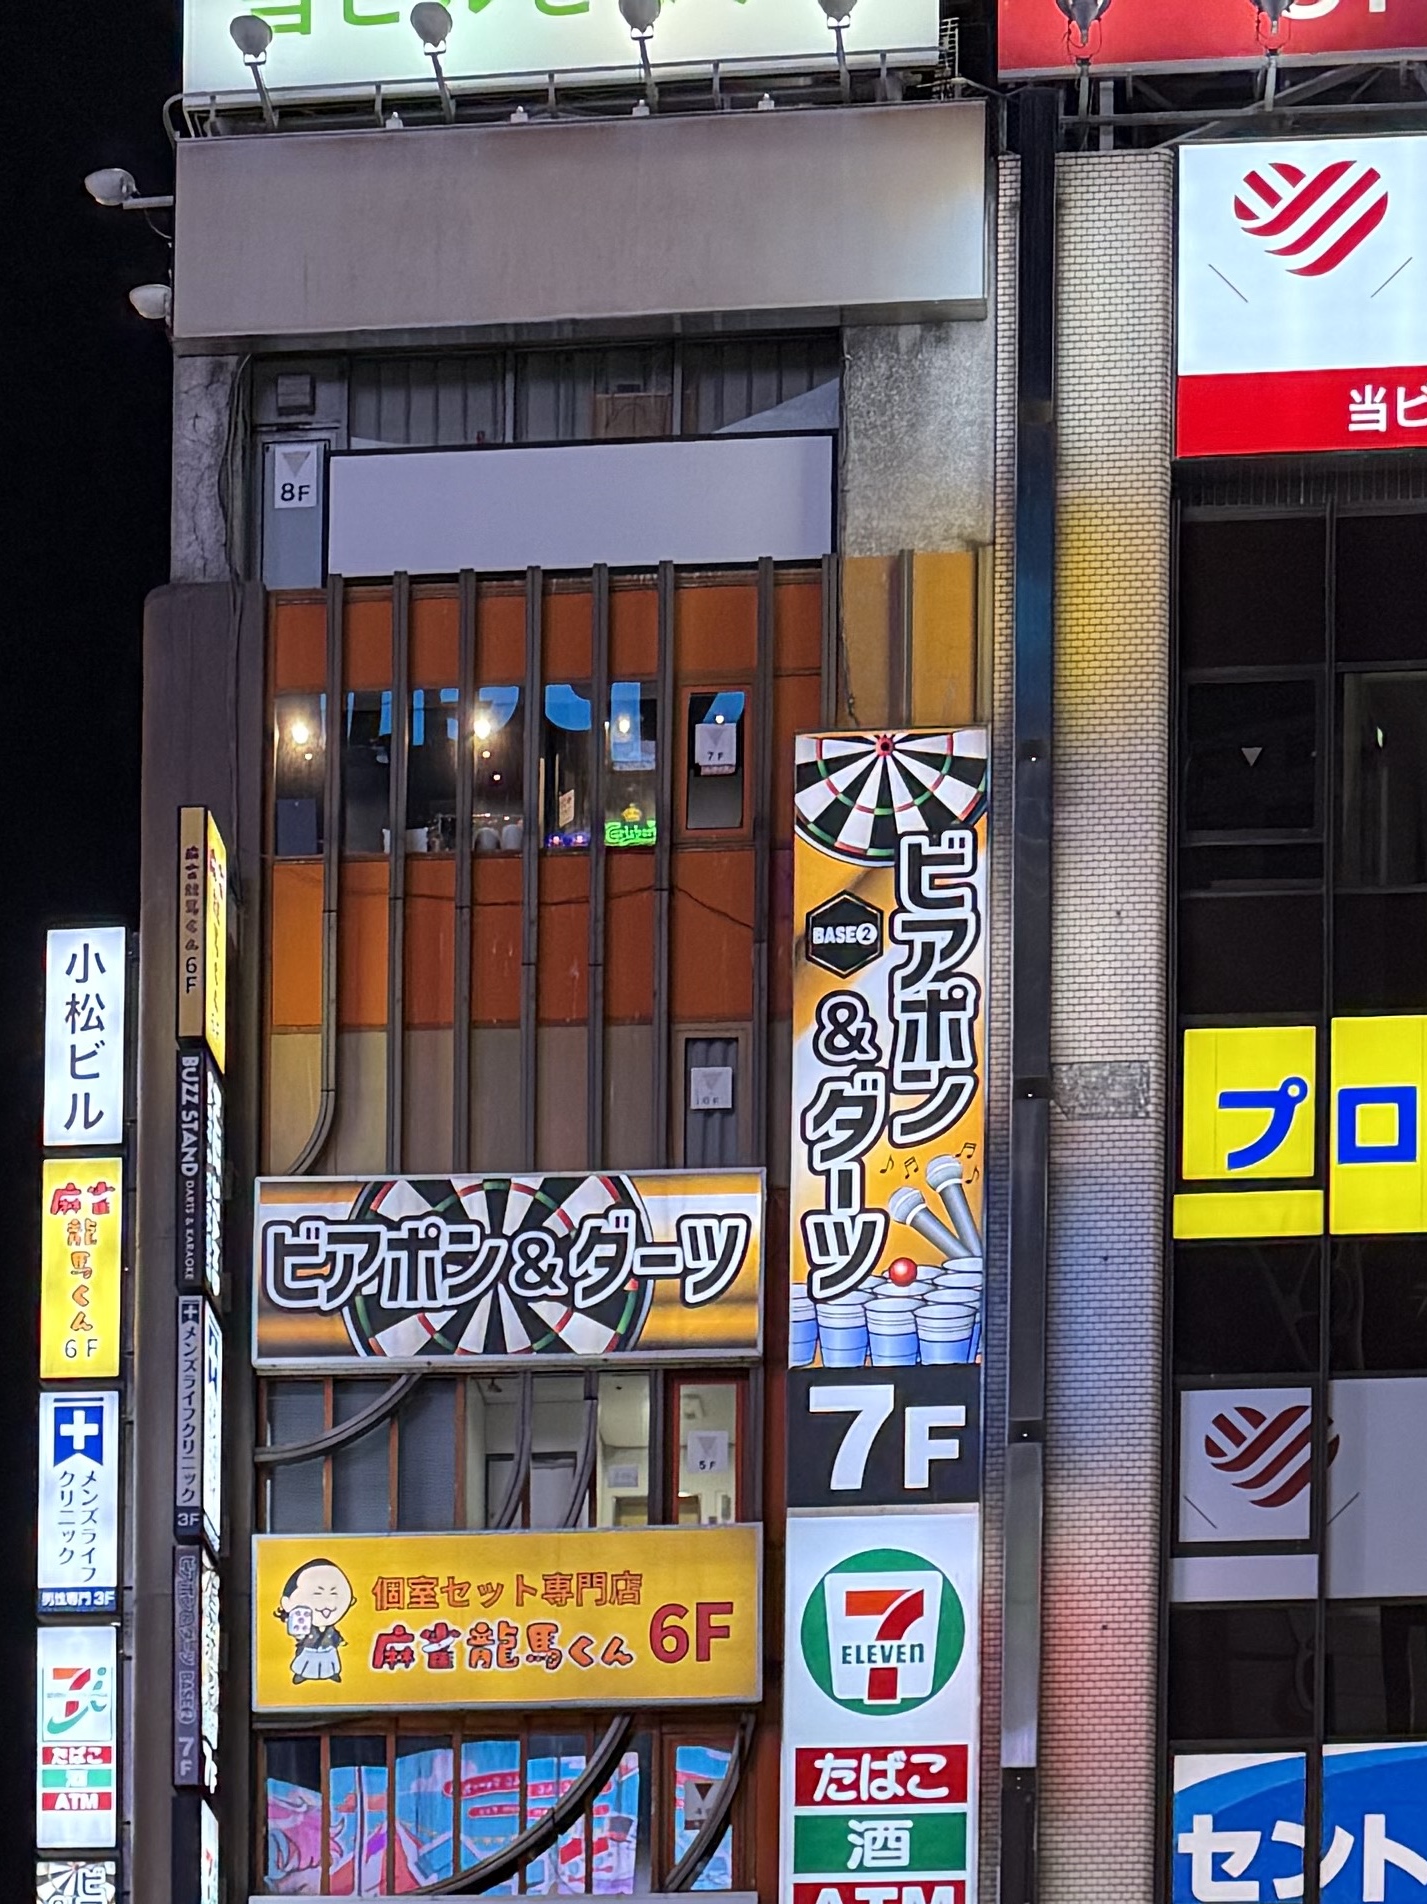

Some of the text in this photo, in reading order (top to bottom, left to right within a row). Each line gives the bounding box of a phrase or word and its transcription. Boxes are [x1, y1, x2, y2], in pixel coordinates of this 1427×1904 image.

[280, 481, 311, 503] 8F
[184, 956, 197, 994] 6F
[890, 828, 980, 1148] ビアポン
[62, 940, 108, 1133] 小松ビル
[180, 1055, 199, 1107] BUZZ
[180, 1110, 199, 1176] STAND
[264, 1208, 753, 1310] ビアポン&ダーツ
[63, 1336, 98, 1360] 6F
[180, 1322, 198, 1505] メンズライフクリニック
[808, 1384, 966, 1490] 7F
[57, 1469, 76, 1565] クリニック
[79, 1469, 99, 1584] メンズライフ
[177, 1511, 201, 1527] 3F
[93, 1590, 116, 1607] 3F
[371, 1570, 643, 1612] 個室セット専門店
[370, 1620, 635, 1672] 麻雀龍馬くん
[648, 1601, 735, 1664] 6F
[54, 1793, 99, 1810] ATM
[813, 1752, 950, 1802] たばこ
[846, 1819, 914, 1870] 酒
